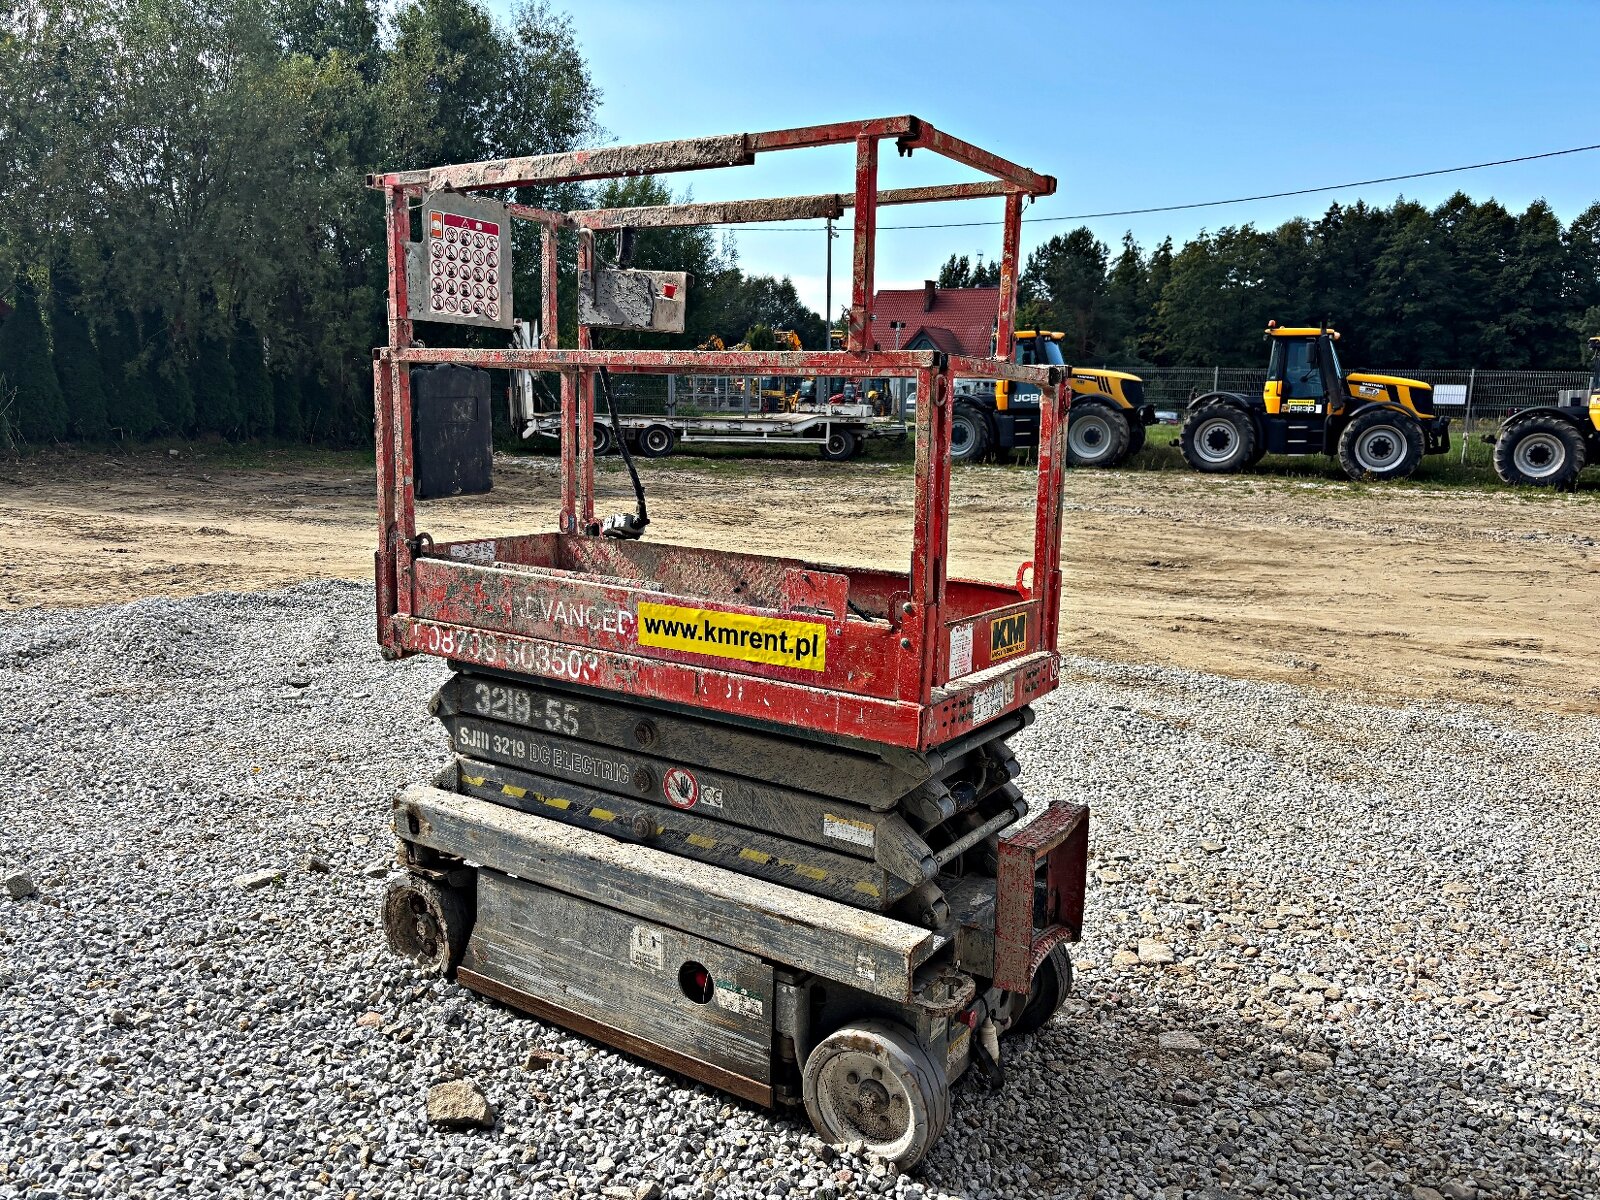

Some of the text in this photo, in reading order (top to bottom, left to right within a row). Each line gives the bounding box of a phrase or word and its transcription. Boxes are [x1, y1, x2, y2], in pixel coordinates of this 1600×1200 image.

[1015, 394, 1039, 403] JCB
[644, 617, 818, 661] www.kmrent.pl
[992, 614, 1026, 650] KM
[475, 683, 580, 736] 3219-55
[493, 735, 526, 759] 3219
[529, 744, 550, 765] DC
[553, 748, 630, 784] ELECTRIC
